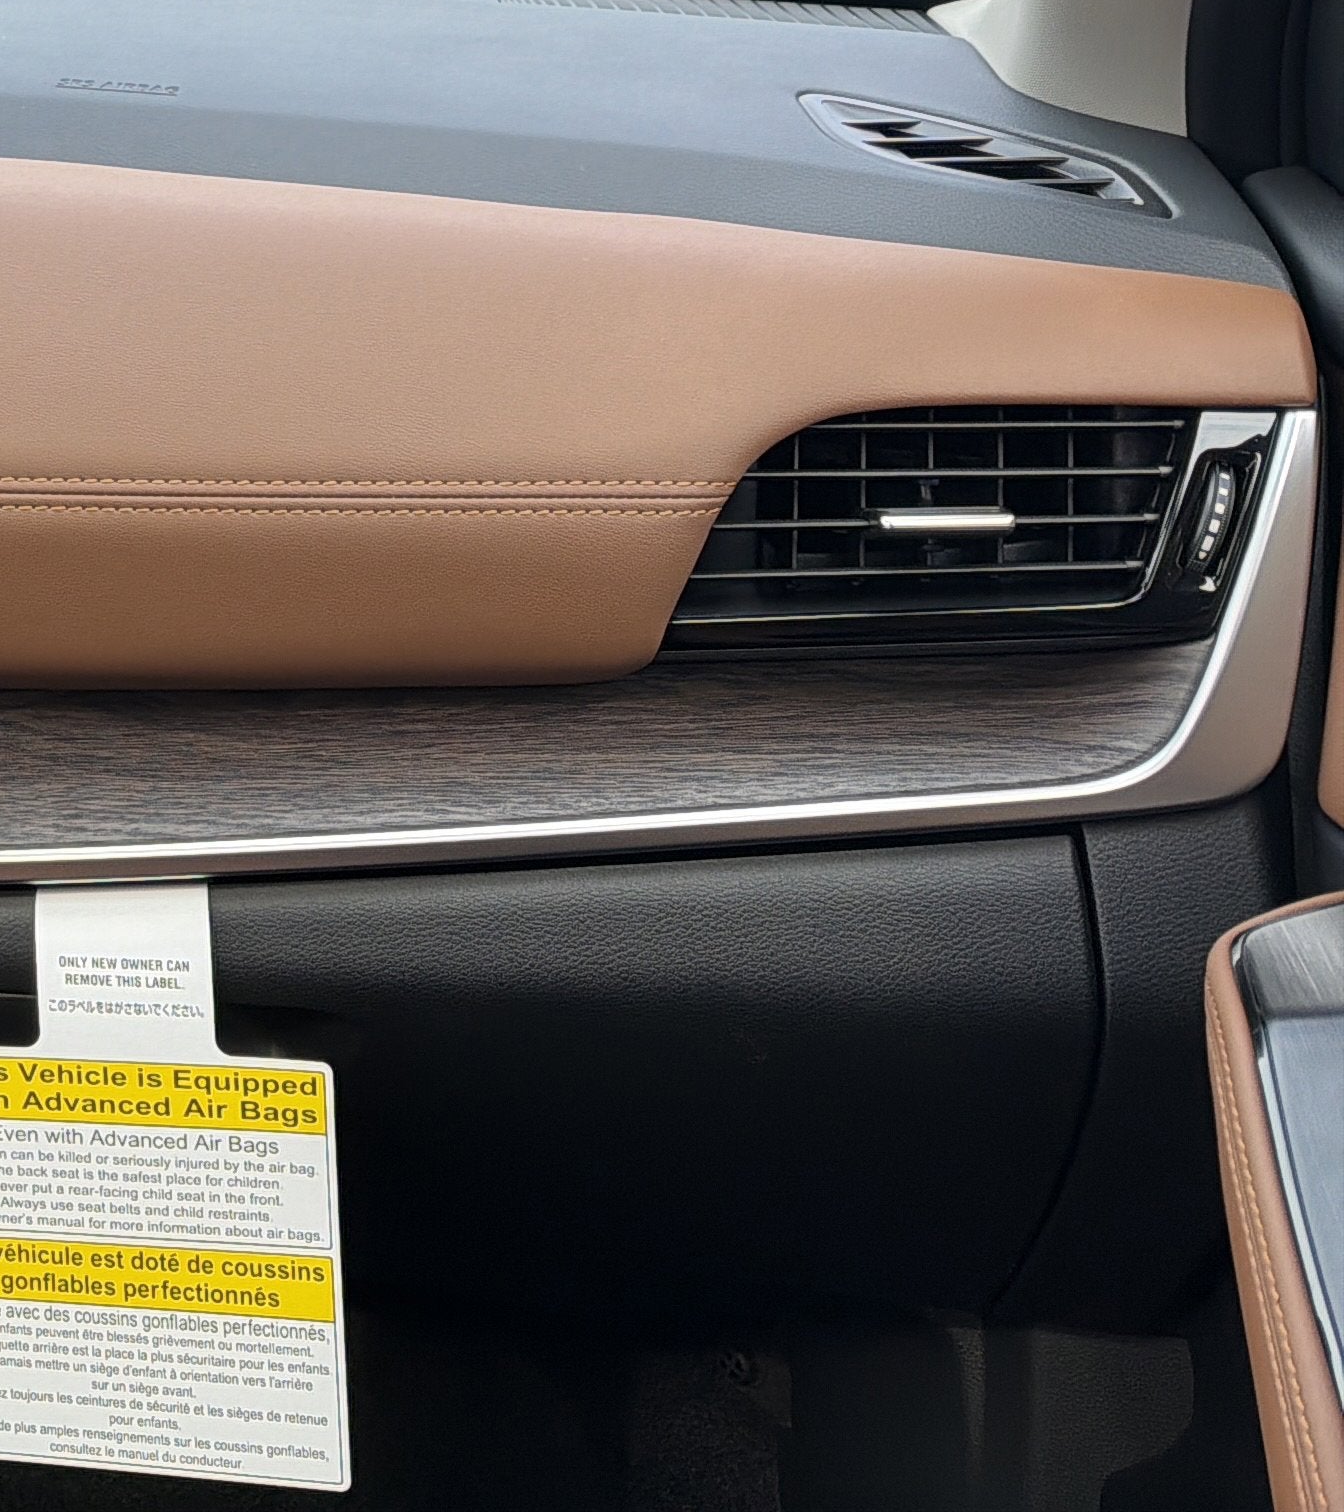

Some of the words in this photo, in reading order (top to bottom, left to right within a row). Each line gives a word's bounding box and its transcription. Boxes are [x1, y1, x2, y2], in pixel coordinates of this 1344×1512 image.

[59, 955, 88, 968] ONLY
[91, 957, 117, 970] NEW
[121, 958, 163, 972] OWNER
[166, 959, 190, 972] CAN
[65, 973, 113, 986] REMOVE
[116, 975, 142, 988] THIS
[146, 976, 185, 989] LABEL.
[18, 1063, 126, 1086] Vehicle
[138, 1072, 162, 1087] is
[173, 1070, 317, 1096] Equipped
[22, 1091, 170, 1116] Advanced
[183, 1098, 227, 1118] Air
[240, 1101, 317, 1127] Bags
[44, 1127, 83, 1145] with
[89, 1129, 187, 1150] Advanced
[194, 1134, 222, 1151] Air
[228, 1136, 279, 1157] Bags
[10, 1150, 34, 1161] can
[37, 1149, 54, 1162] be
[58, 1151, 91, 1164] killed
[95, 1155, 111, 1165] or
[112, 1155, 171, 1170] seriously
[174, 1157, 219, 1171] injured
[223, 1160, 240, 1174] by
[243, 1161, 267, 1174] the
[268, 1163, 286, 1173] air
[16, 1164, 48, 1177] back
[51, 1168, 79, 1179] seat
[83, 1168, 94, 1180] is
[97, 1169, 118, 1181] the
[122, 1171, 162, 1184] safest
[165, 1173, 201, 1186] place
[205, 1175, 225, 1187] for
[37, 1216, 85, 1227] manual
[88, 1217, 107, 1229] for
[109, 1220, 143, 1231] more
[147, 1221, 221, 1235] information
[225, 1226, 263, 1238] about
[266, 1229, 284, 1239] air
[287, 1230, 324, 1243] bags.
[90, 1251, 124, 1269] est
[131, 1251, 179, 1272] doté
[187, 1255, 213, 1274] de
[221, 1261, 325, 1282] coussins
[1, 1273, 115, 1295] gonflables
[124, 1280, 279, 1307] perfectionnés
[5, 1305, 40, 1320] avec
[43, 1305, 70, 1322] des
[74, 1310, 137, 1327] coussins
[142, 1314, 218, 1333] gonflables
[223, 1320, 330, 1344] perfectionnés,
